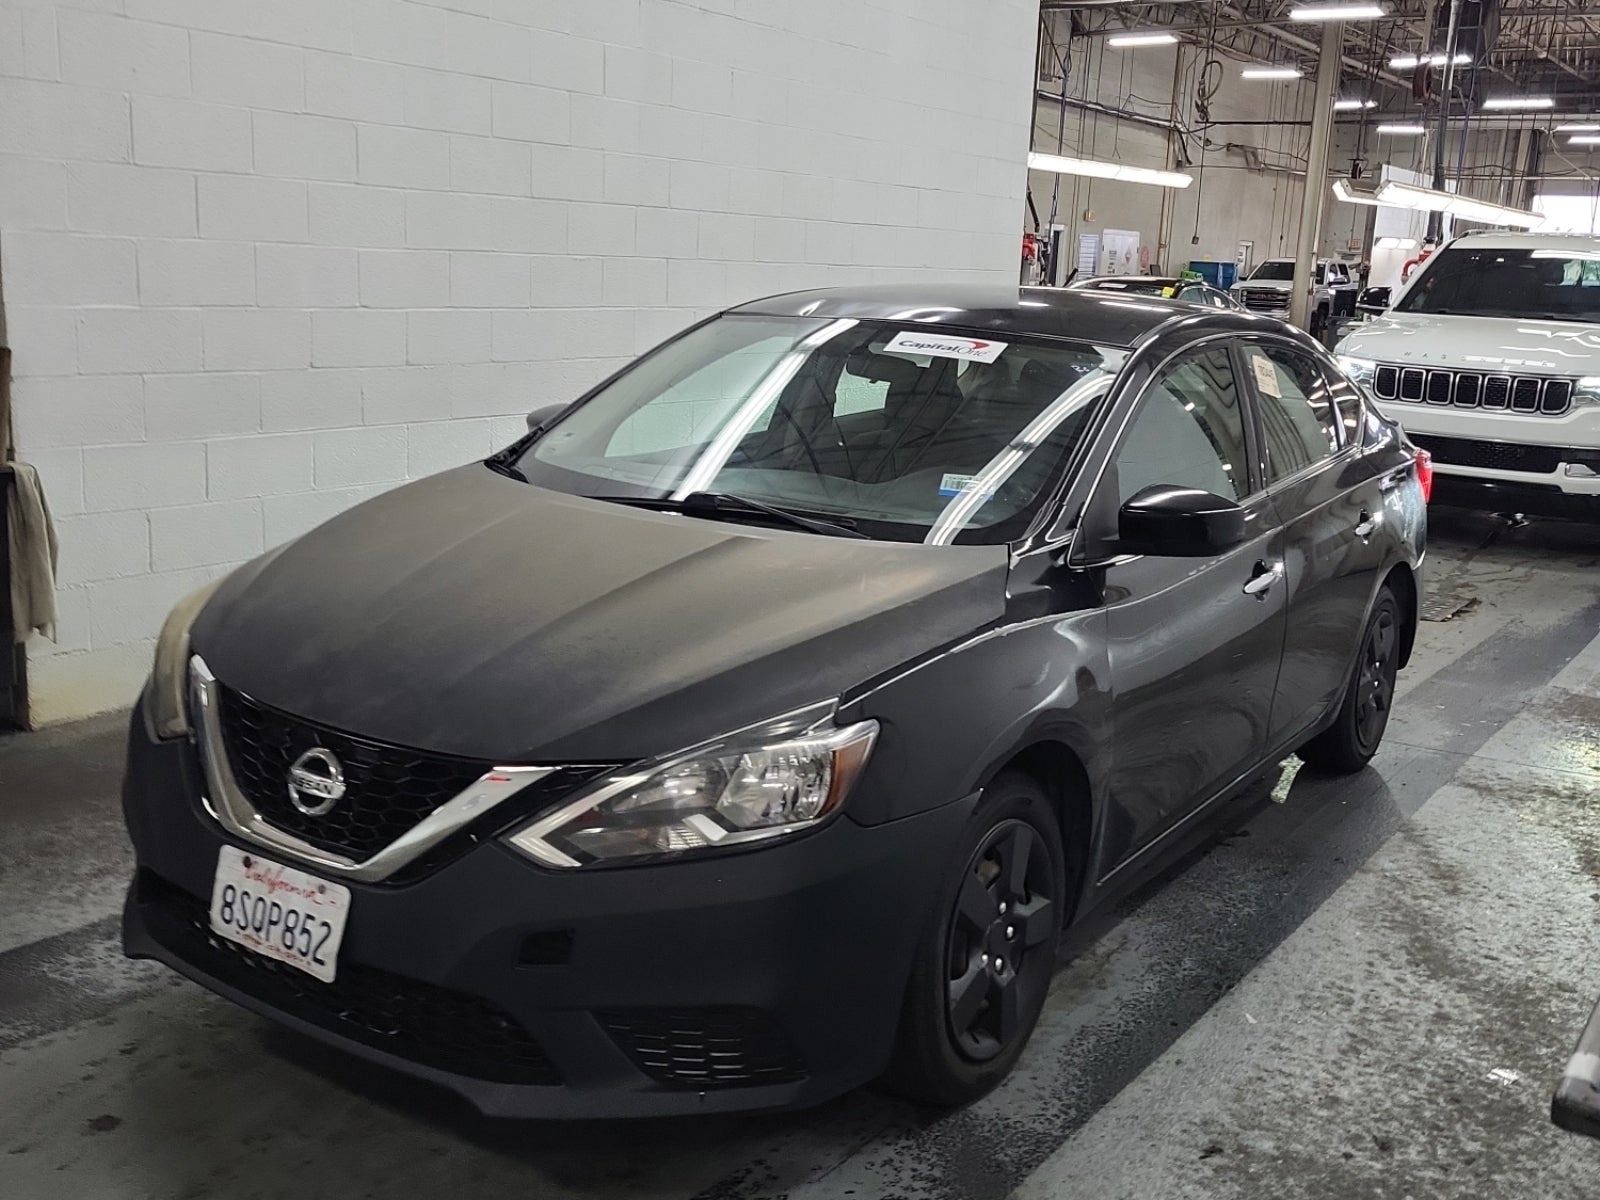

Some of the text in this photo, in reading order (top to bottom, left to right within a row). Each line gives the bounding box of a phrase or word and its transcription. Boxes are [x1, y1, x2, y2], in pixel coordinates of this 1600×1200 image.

[290, 772, 335, 796] NISSAN
[244, 861, 321, 905] California
[220, 884, 332, 967] 8SQP852
